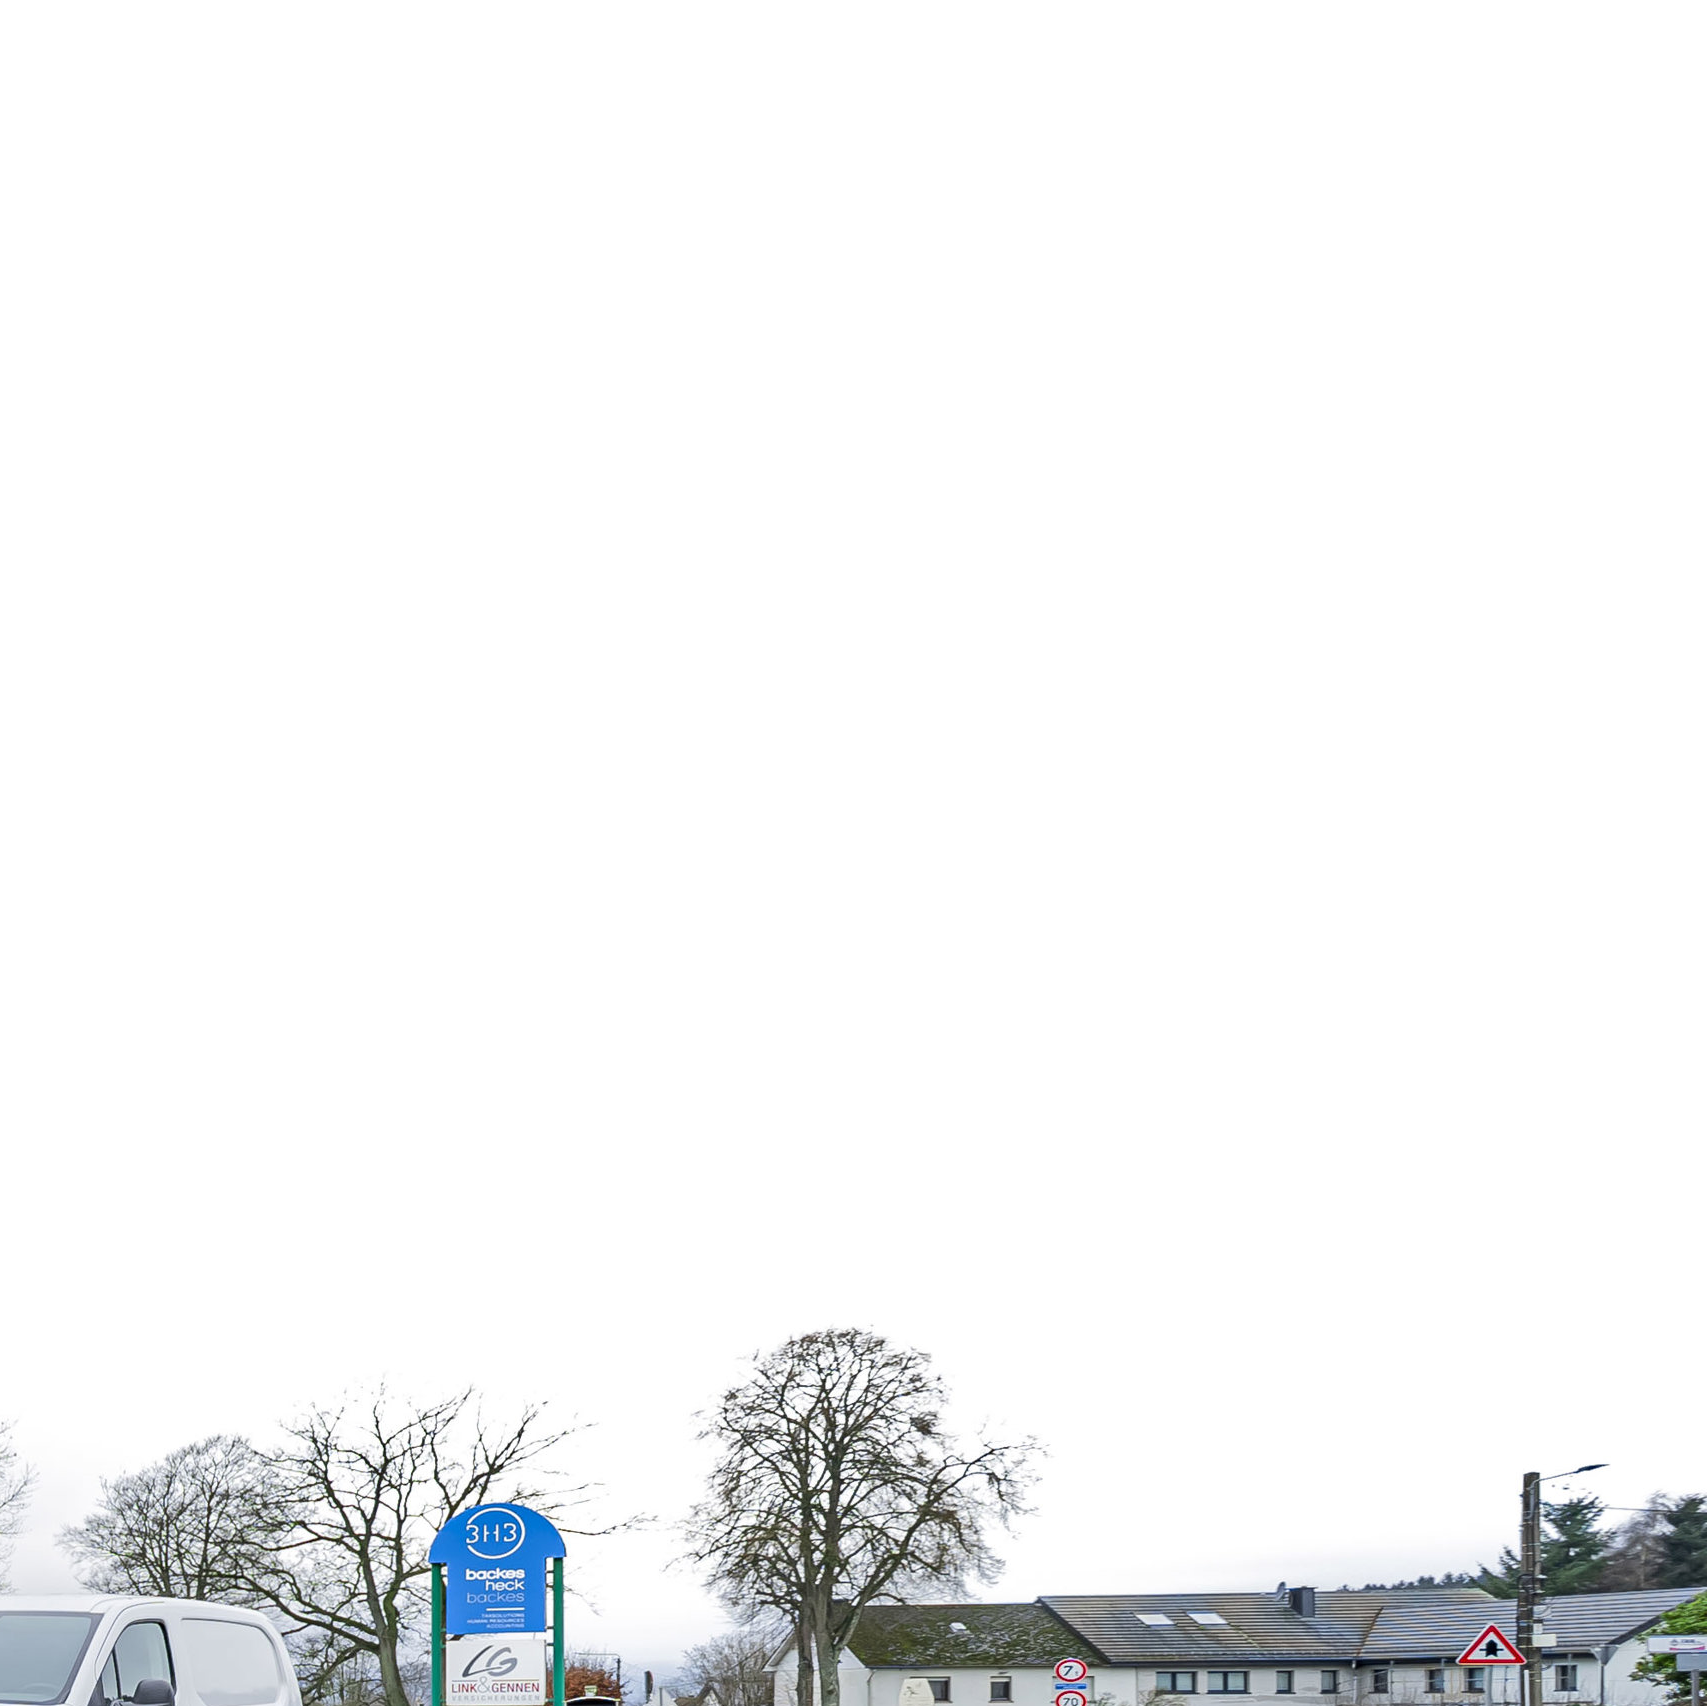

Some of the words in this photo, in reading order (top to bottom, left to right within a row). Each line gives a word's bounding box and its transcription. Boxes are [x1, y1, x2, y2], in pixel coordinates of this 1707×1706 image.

[465, 1567, 525, 1580] backes
[485, 1579, 525, 1591] heck
[467, 1592, 525, 1603] backes
[462, 1645, 518, 1678] LG
[1063, 1665, 1074, 1677] 7
[1062, 1697, 1079, 1706] 70
